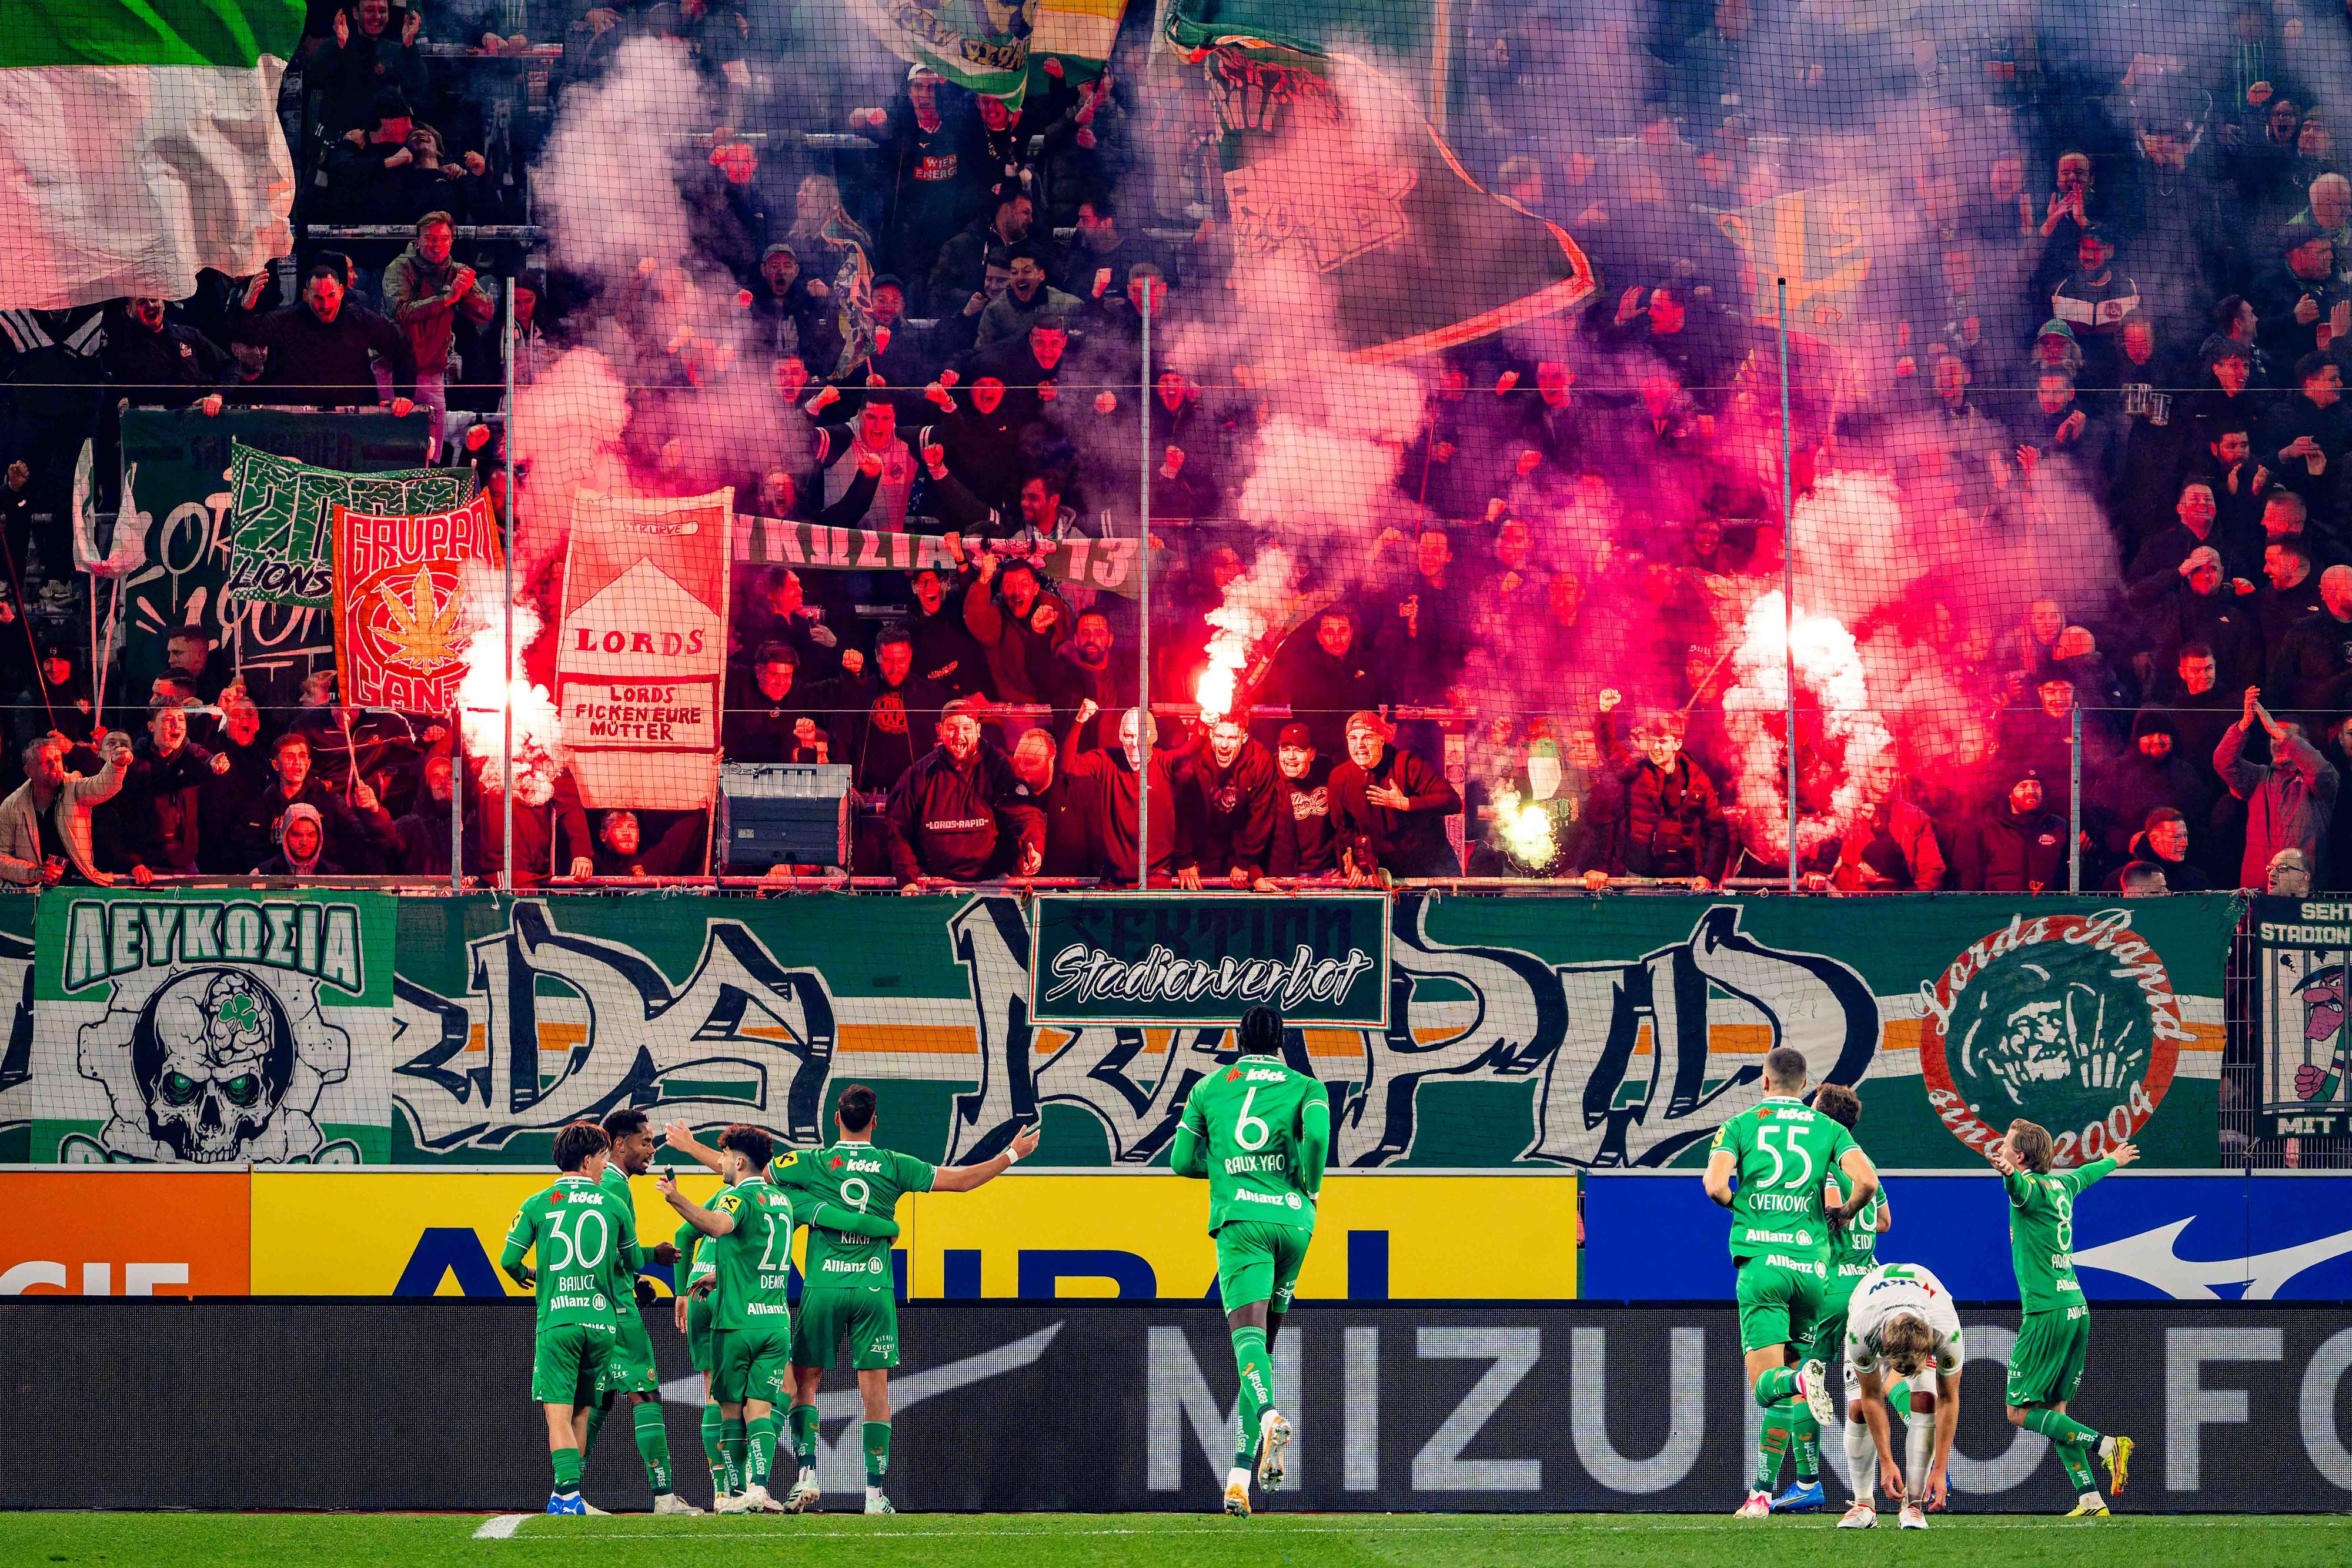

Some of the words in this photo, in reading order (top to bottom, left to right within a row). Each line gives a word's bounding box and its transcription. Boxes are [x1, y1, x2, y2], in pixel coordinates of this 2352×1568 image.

[916, 167, 957, 179] ENERG
[352, 499, 495, 574] GRUPPO
[1062, 537, 1138, 587] 13
[229, 555, 333, 599] LIONS
[574, 628, 705, 656] LORDS
[610, 686, 676, 703] LORDS
[576, 704, 648, 722] FICKEN
[651, 707, 701, 724] EURE
[590, 721, 674, 740] MÜTTER
[1046, 944, 1374, 1011] Stadionverbot
[1245, 1068, 1288, 1082] köck
[1235, 1086, 1269, 1151] 6
[1776, 1108, 1816, 1122] köck
[2053, 1079, 2154, 1167] 2004
[2278, 1116, 2336, 1135] MIT
[846, 1159, 882, 1173] köck
[1225, 1154, 1285, 1174] RAUX-YAO
[1757, 1125, 1812, 1189] 55
[568, 1191, 604, 1205] köck
[840, 1178, 870, 1213] 9
[1235, 1188, 1284, 1205] Allianz
[1748, 1191, 1815, 1212] CVETKOVIĆ
[2057, 1195, 2072, 1251] 8
[545, 1209, 608, 1271] 30
[757, 1213, 790, 1271] 22
[1746, 1229, 1795, 1243] Allianz
[822, 1259, 867, 1272] Allianz
[1766, 1254, 1813, 1274] Allianz
[559, 1274, 595, 1292] BAJLICZ
[550, 1295, 590, 1311] Allianz
[747, 1302, 785, 1315] Allianz
